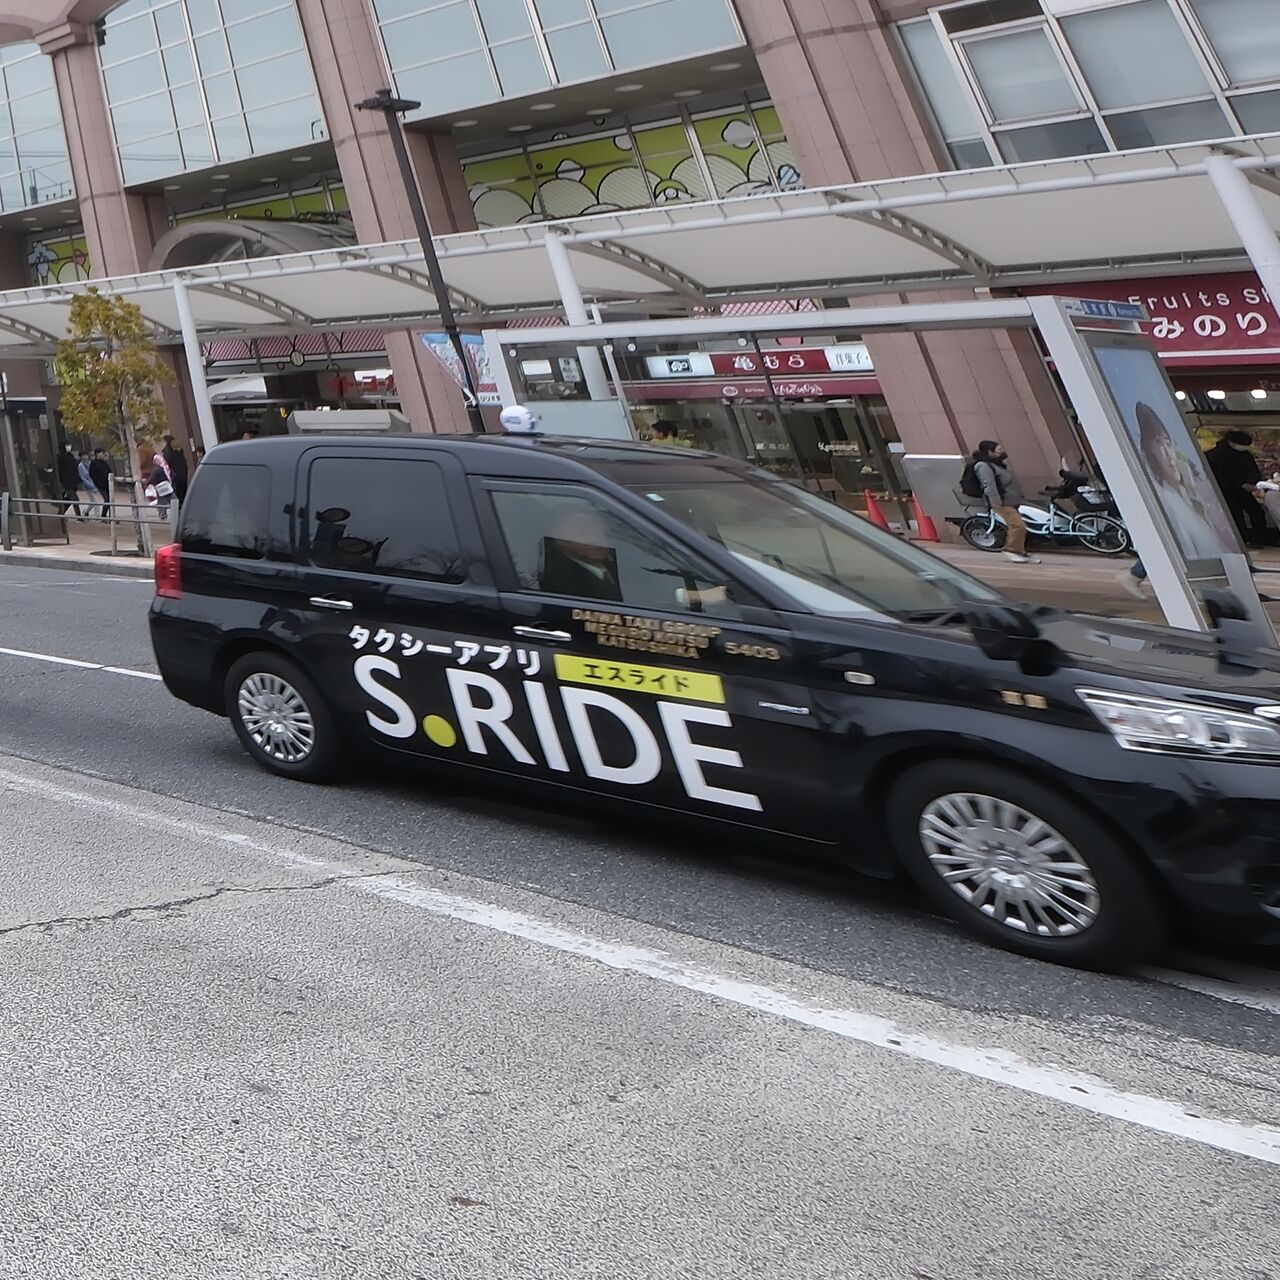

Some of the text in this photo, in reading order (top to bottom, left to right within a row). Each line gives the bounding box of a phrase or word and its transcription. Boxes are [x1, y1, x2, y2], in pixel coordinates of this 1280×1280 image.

[1128, 290, 1230, 311] Fruits
[1151, 311, 1268, 340] みのり
[661, 619, 722, 639] GROUP
[347, 624, 542, 676] タクシーアプリ
[724, 641, 781, 661] 5403
[583, 663, 690, 693] エスライド
[351, 653, 764, 813] S.RIDE
